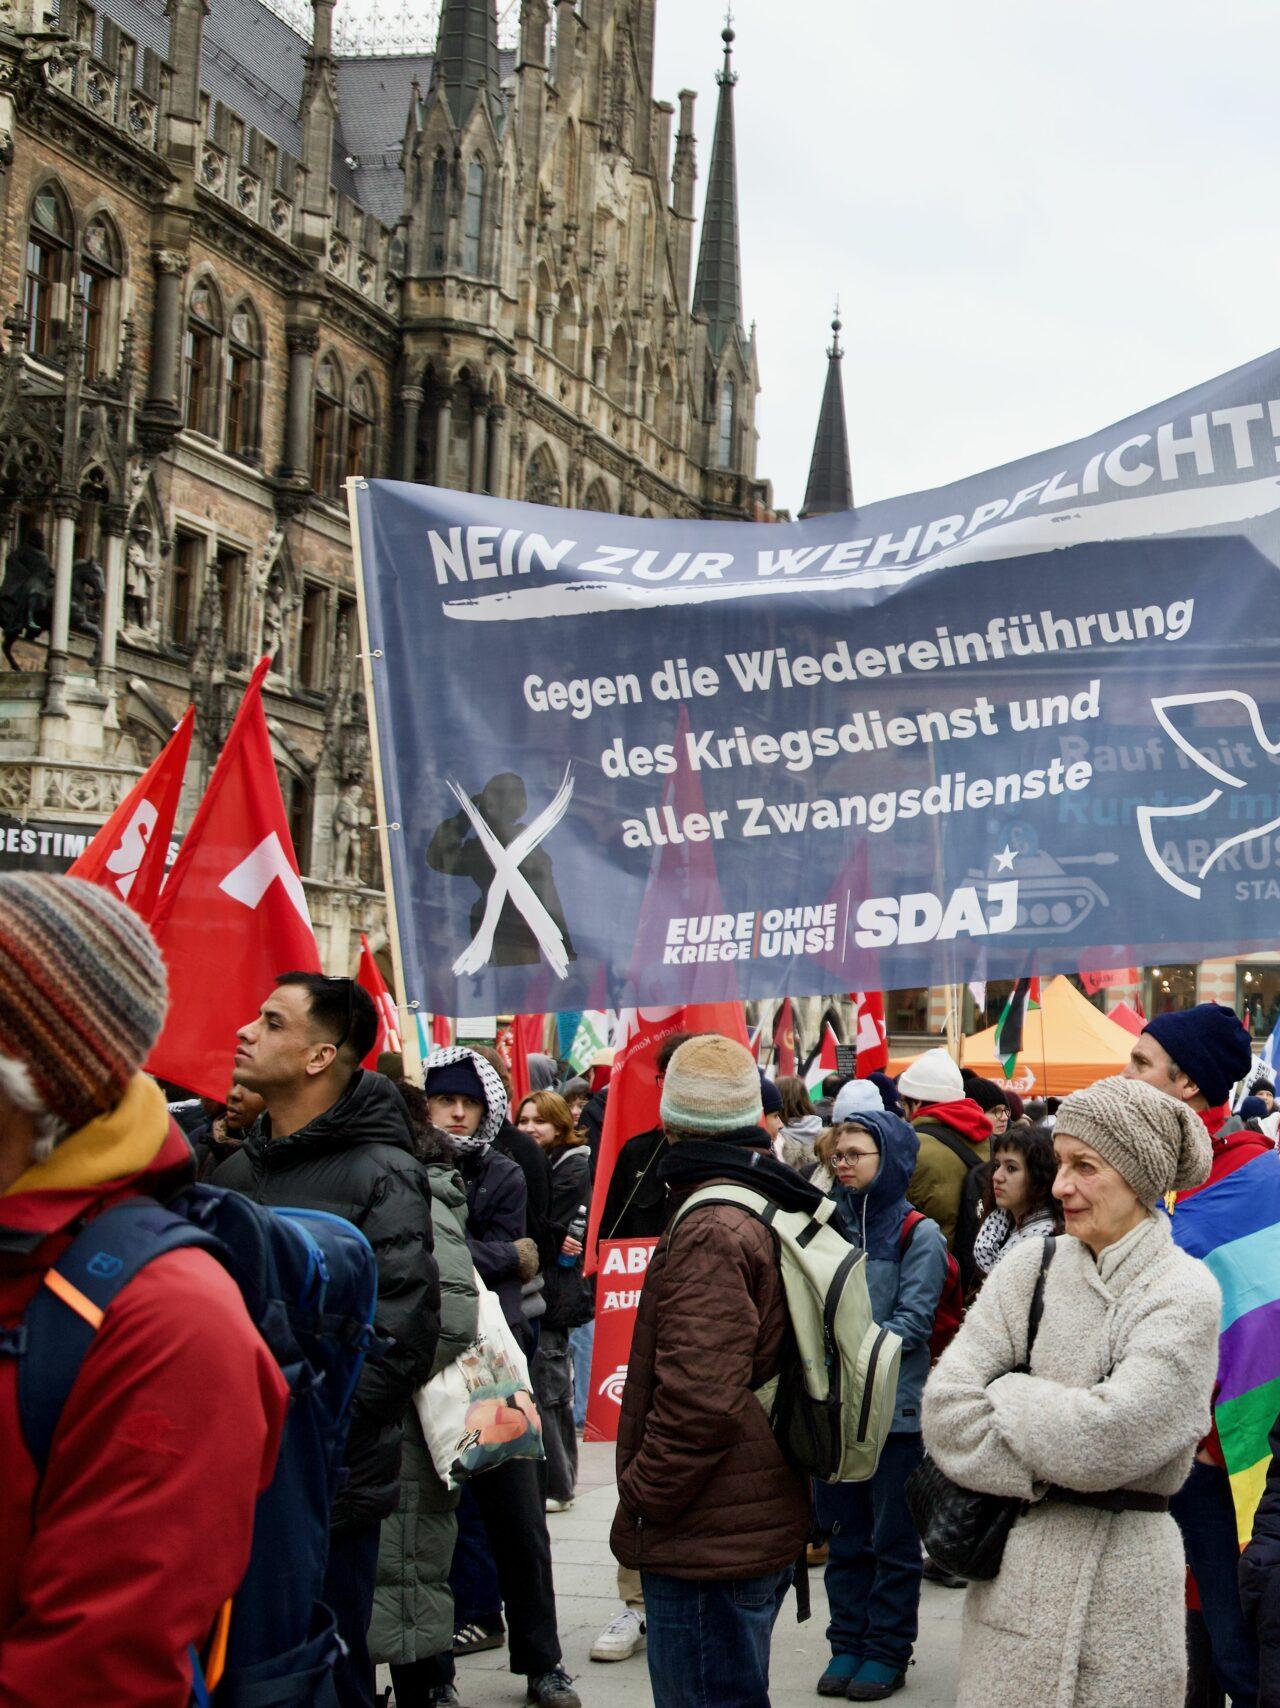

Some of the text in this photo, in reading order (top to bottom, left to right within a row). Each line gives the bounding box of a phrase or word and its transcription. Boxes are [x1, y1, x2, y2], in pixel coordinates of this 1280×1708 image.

[426, 525, 578, 585] NEIN
[577, 545, 735, 581] ZUR
[523, 598, 1195, 721] Gegen die Wiedereinführung
[601, 679, 1101, 779] des Kriegsdienst und
[621, 756, 1092, 848] aller Zwangsdienste
[663, 925, 835, 965] KRIEGE UNS!
[665, 903, 837, 945] EURE OHNE
[854, 880, 1019, 949] SDAJ
